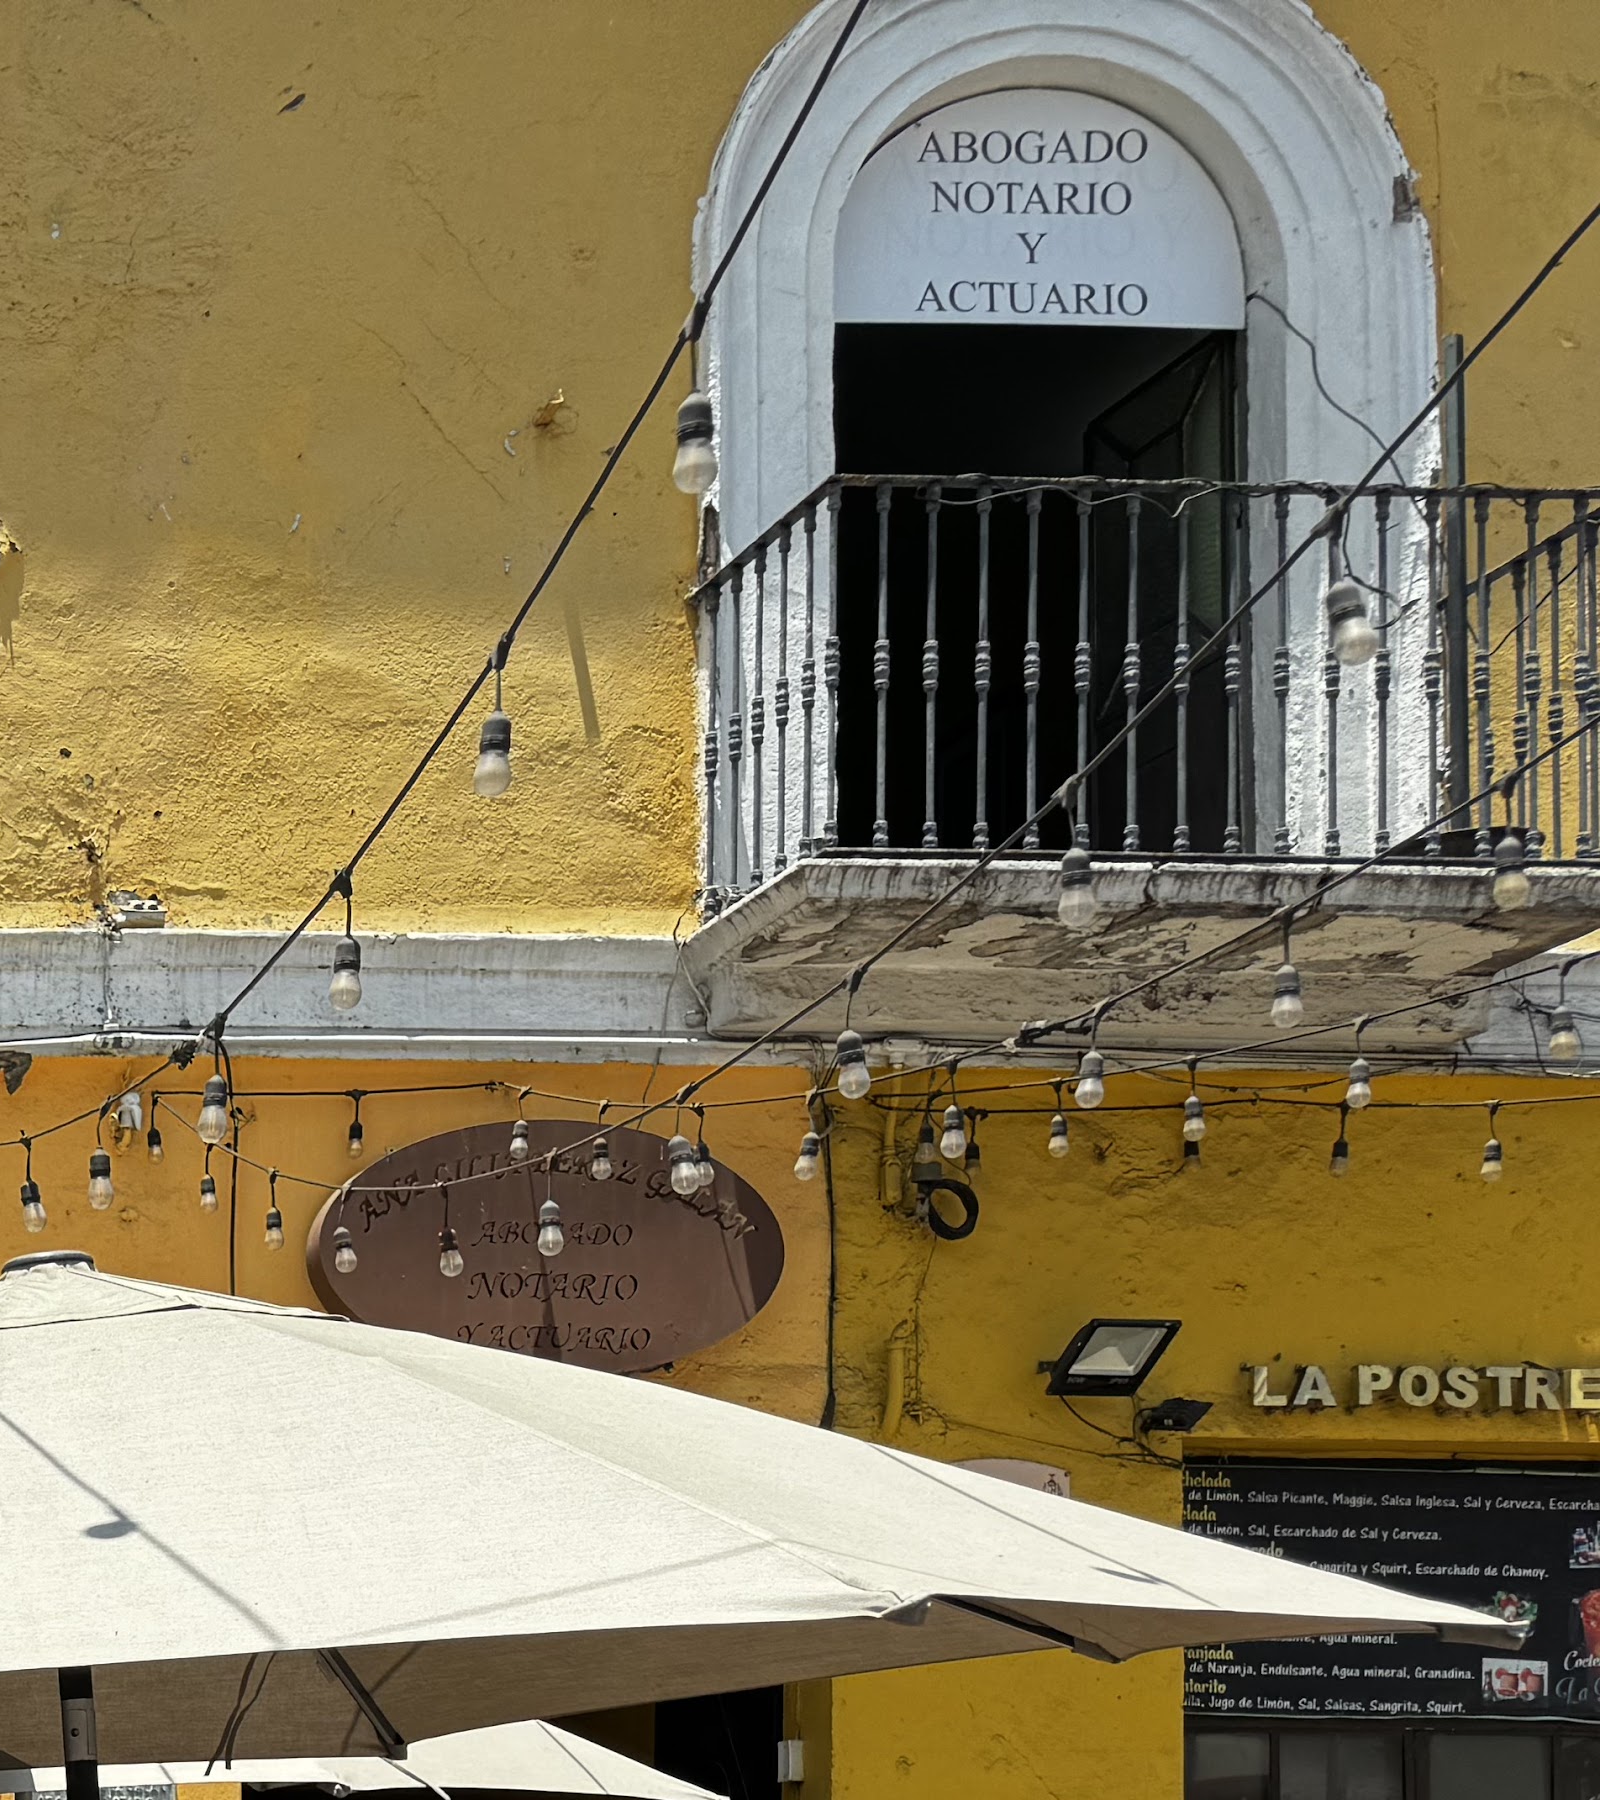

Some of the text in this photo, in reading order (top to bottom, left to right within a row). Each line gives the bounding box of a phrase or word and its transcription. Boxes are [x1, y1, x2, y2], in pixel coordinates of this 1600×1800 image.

[917, 127, 1149, 165] ABOGADO
[930, 180, 1133, 216] NOTARIO
[1016, 231, 1049, 265] Y
[914, 280, 1149, 317] ACTUARIO
[471, 1220, 635, 1247] ABOADO
[466, 1271, 640, 1306] NOTARIO
[456, 1322, 653, 1356] Y ACTUARIO
[1251, 1363, 1339, 1408] LA
[1188, 1489, 1202, 1501] de
[1247, 1491, 1278, 1504] Salsa
[1381, 1494, 1412, 1507] Salsa
[1463, 1496, 1482, 1508] Sal
[1484, 1499, 1492, 1511] y
[1273, 1525, 1339, 1539] Escarchado
[1342, 1527, 1357, 1539] de
[1360, 1527, 1379, 1540] Sal
[1381, 1530, 1390, 1542] y
[1360, 1563, 1369, 1577] y
[1415, 1562, 1480, 1577] Escarchado
[1484, 1564, 1499, 1577] de
[1189, 1662, 1204, 1674] de
[1331, 1665, 1361, 1680] Agua
[1208, 1696, 1235, 1711] Jugo
[1238, 1697, 1254, 1708] de
